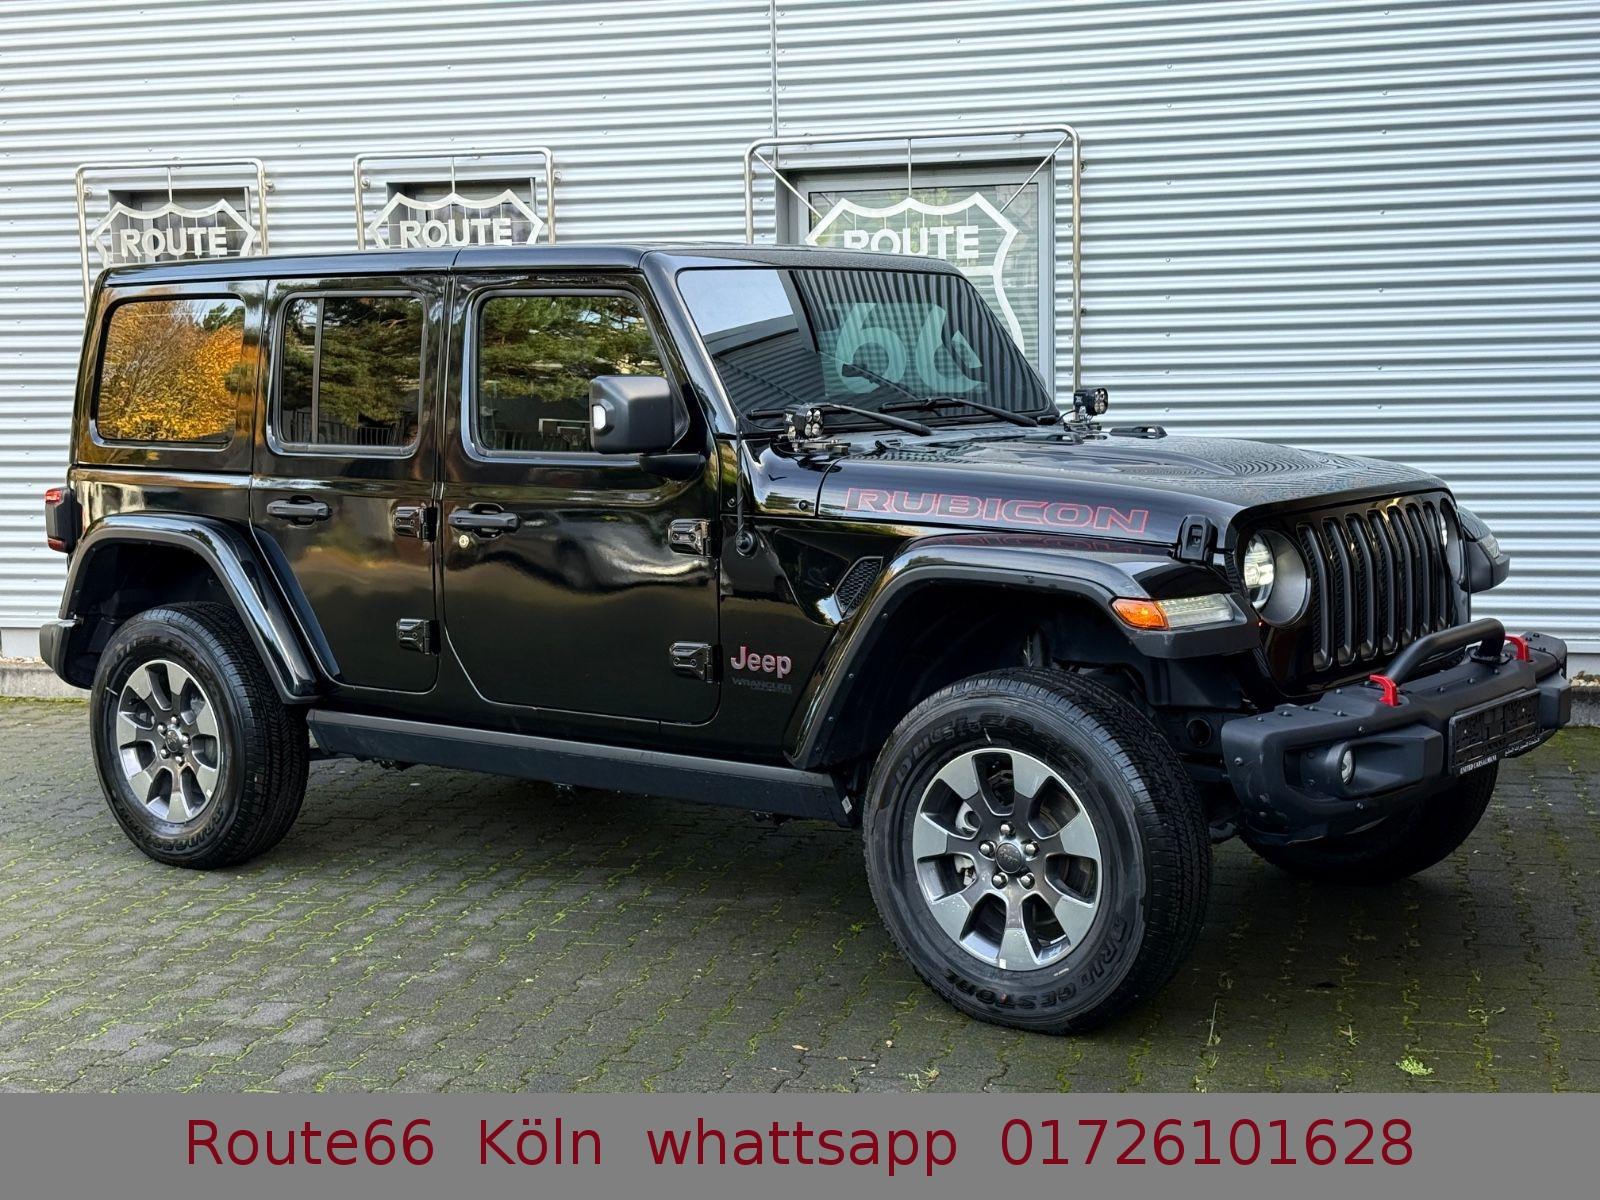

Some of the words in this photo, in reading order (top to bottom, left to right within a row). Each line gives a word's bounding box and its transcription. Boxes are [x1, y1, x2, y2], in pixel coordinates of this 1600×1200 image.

[119, 226, 228, 258] ROUTE
[399, 217, 513, 248] ROUTE
[844, 224, 979, 260] ROUTE
[844, 486, 1149, 534] RUBICON
[730, 646, 792, 679] Jeep
